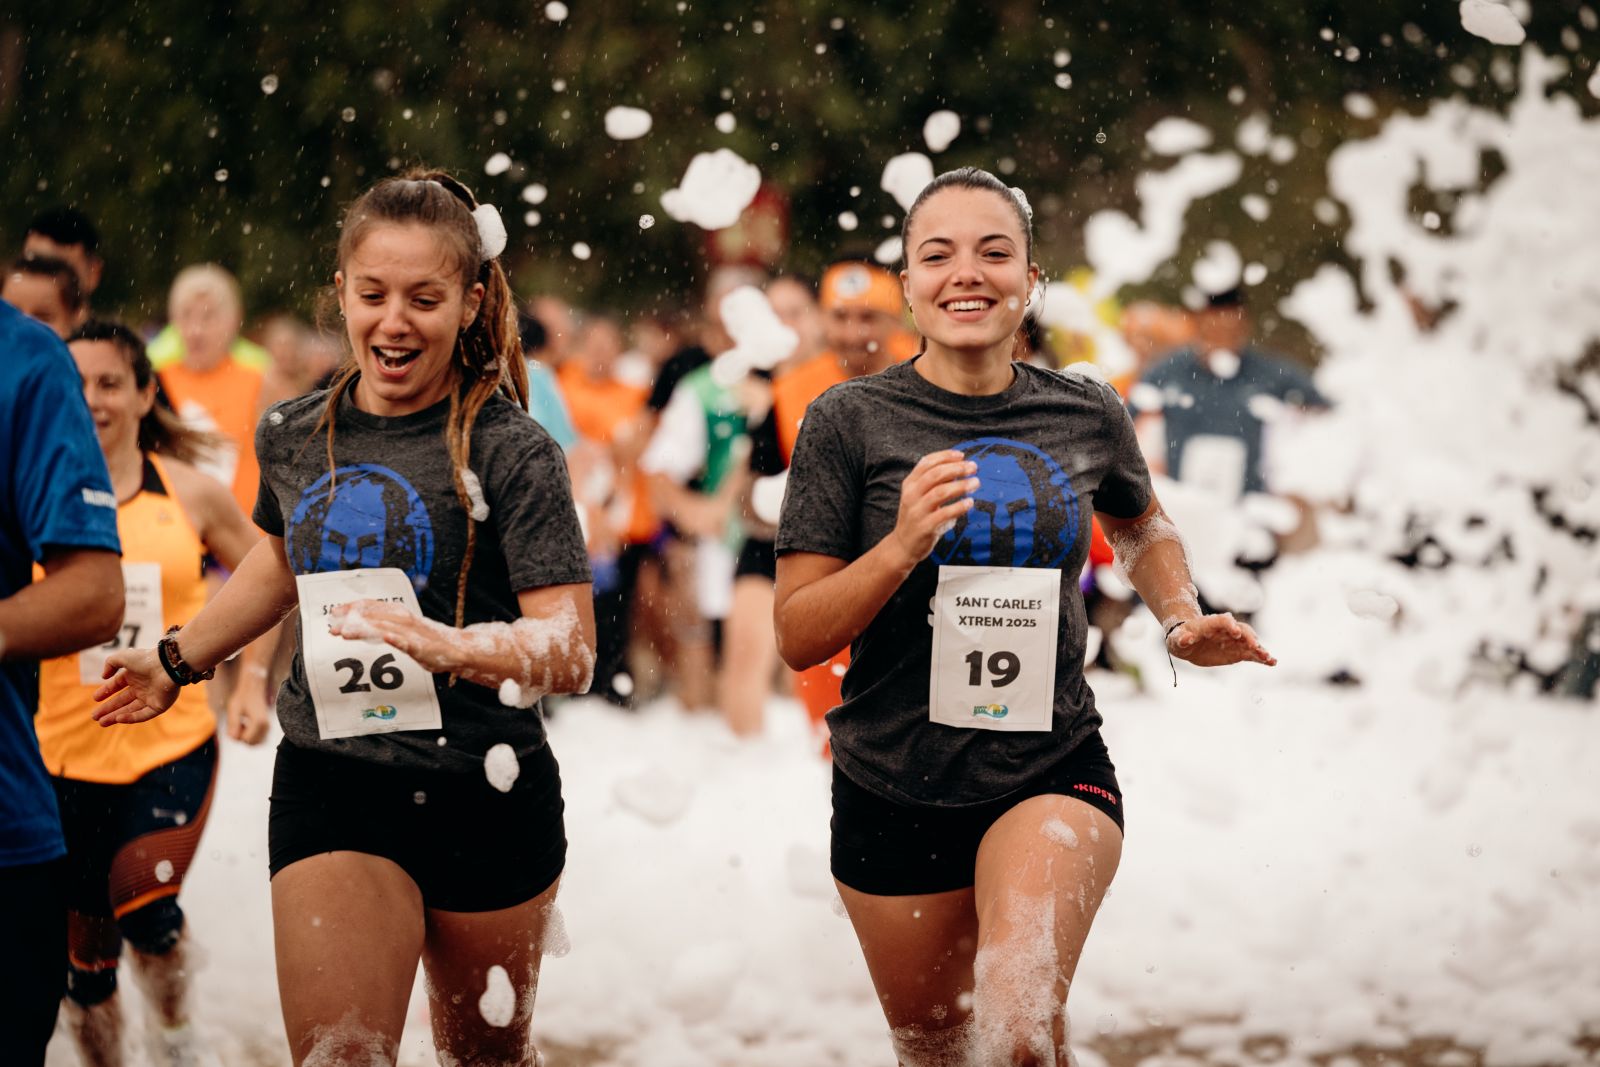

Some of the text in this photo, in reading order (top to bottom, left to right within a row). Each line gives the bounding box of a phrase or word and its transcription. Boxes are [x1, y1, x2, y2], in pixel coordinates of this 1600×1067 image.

[955, 596, 1042, 610] SANT CARLES
[958, 615, 1037, 627] XTREM 2025
[333, 652, 404, 694] 26
[964, 649, 1021, 688] 19
